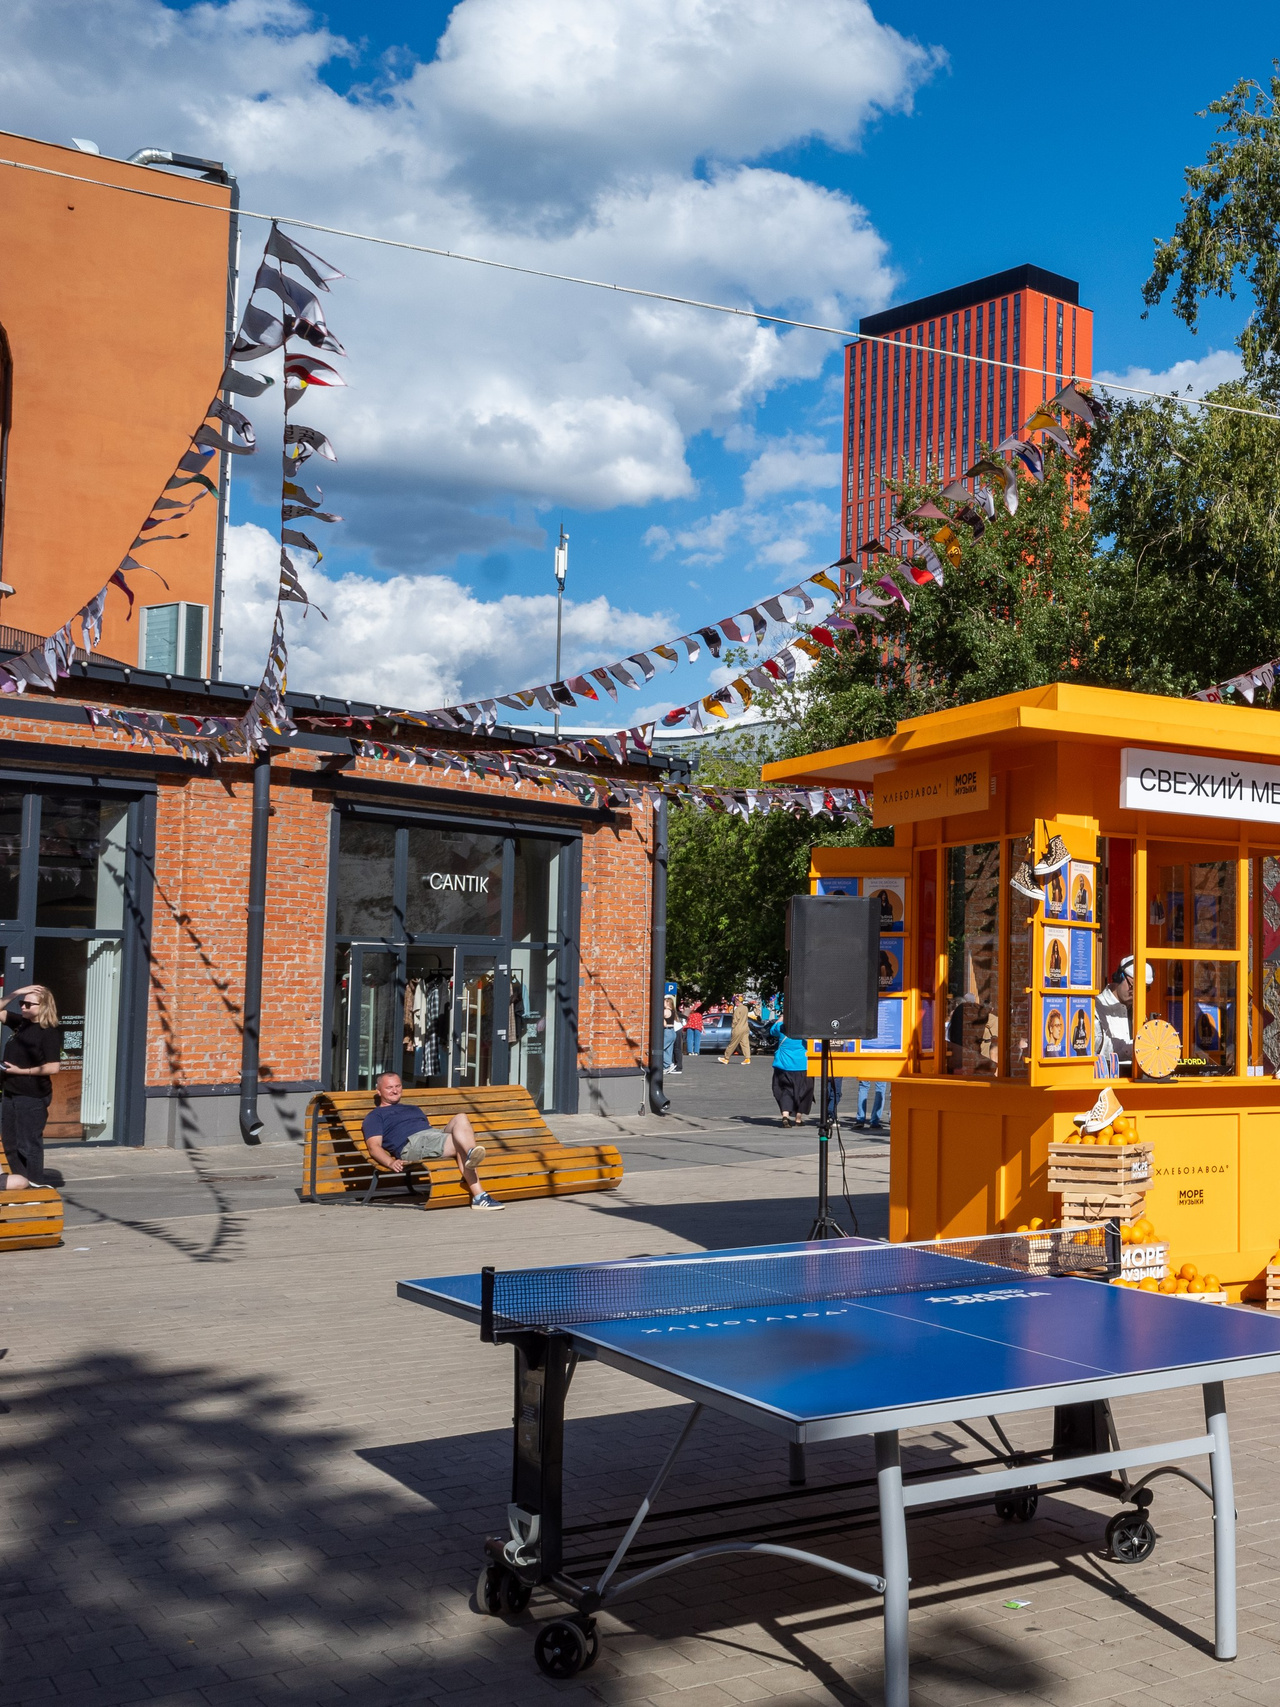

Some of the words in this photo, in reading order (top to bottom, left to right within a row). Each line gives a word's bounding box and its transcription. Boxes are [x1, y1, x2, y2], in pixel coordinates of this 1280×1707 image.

[955, 771, 977, 786] МОРЕ
[1140, 767, 1243, 800] СВЕЖИЙ
[954, 785, 977, 796] МУЗЫКИ
[429, 873, 489, 894] CANTIK
[668, 984, 674, 992] P
[1132, 1161, 1148, 1171] МОРЕ
[1179, 1190, 1204, 1198] МОРЕ
[1121, 1246, 1164, 1267] МОРЕ
[641, 1309, 848, 1334] ХЛЕБОЗАВОД
